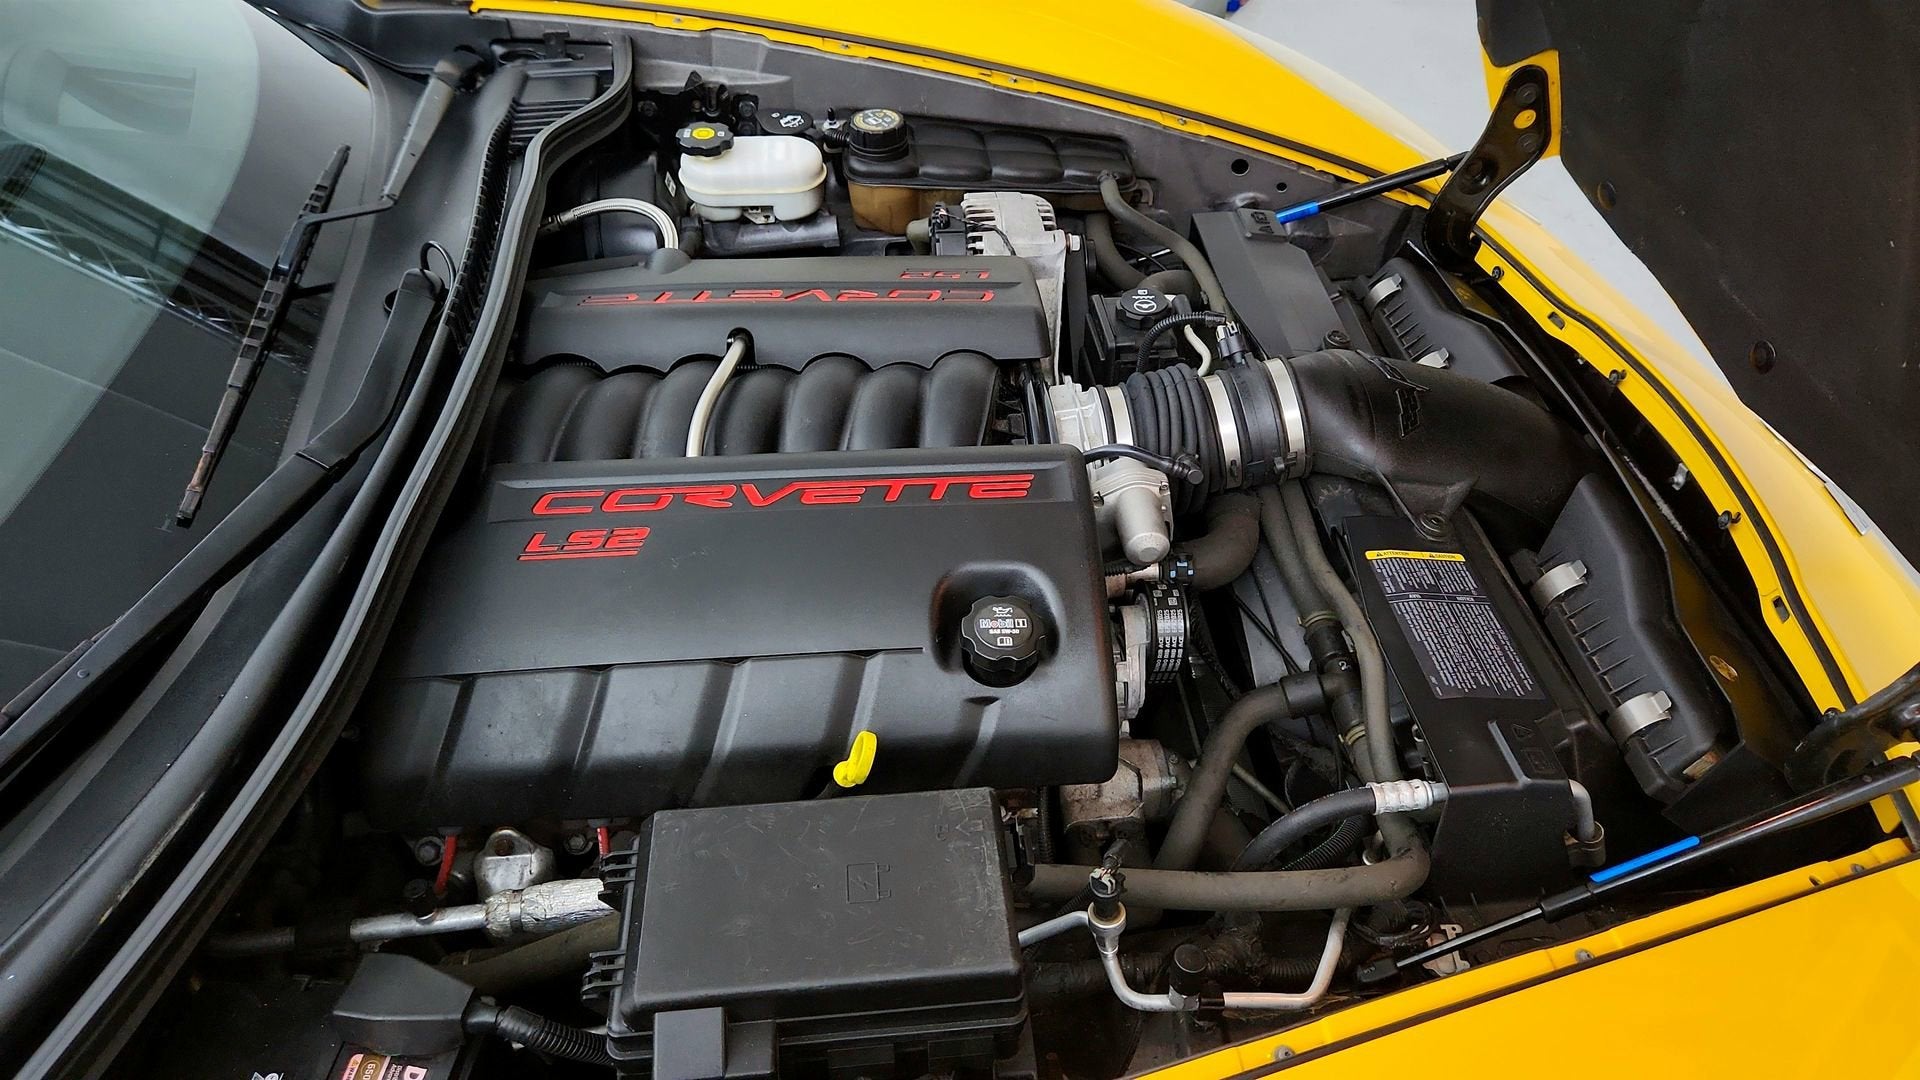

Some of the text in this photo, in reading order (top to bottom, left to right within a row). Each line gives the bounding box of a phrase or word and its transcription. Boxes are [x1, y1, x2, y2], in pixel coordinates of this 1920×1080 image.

[900, 269, 991, 280] LS2
[578, 289, 995, 305] CORVETTE
[532, 473, 1034, 516] CORVETTE
[525, 526, 650, 553] LS2
[980, 619, 1014, 628] Mobil
[362, 1063, 376, 1080] 650
